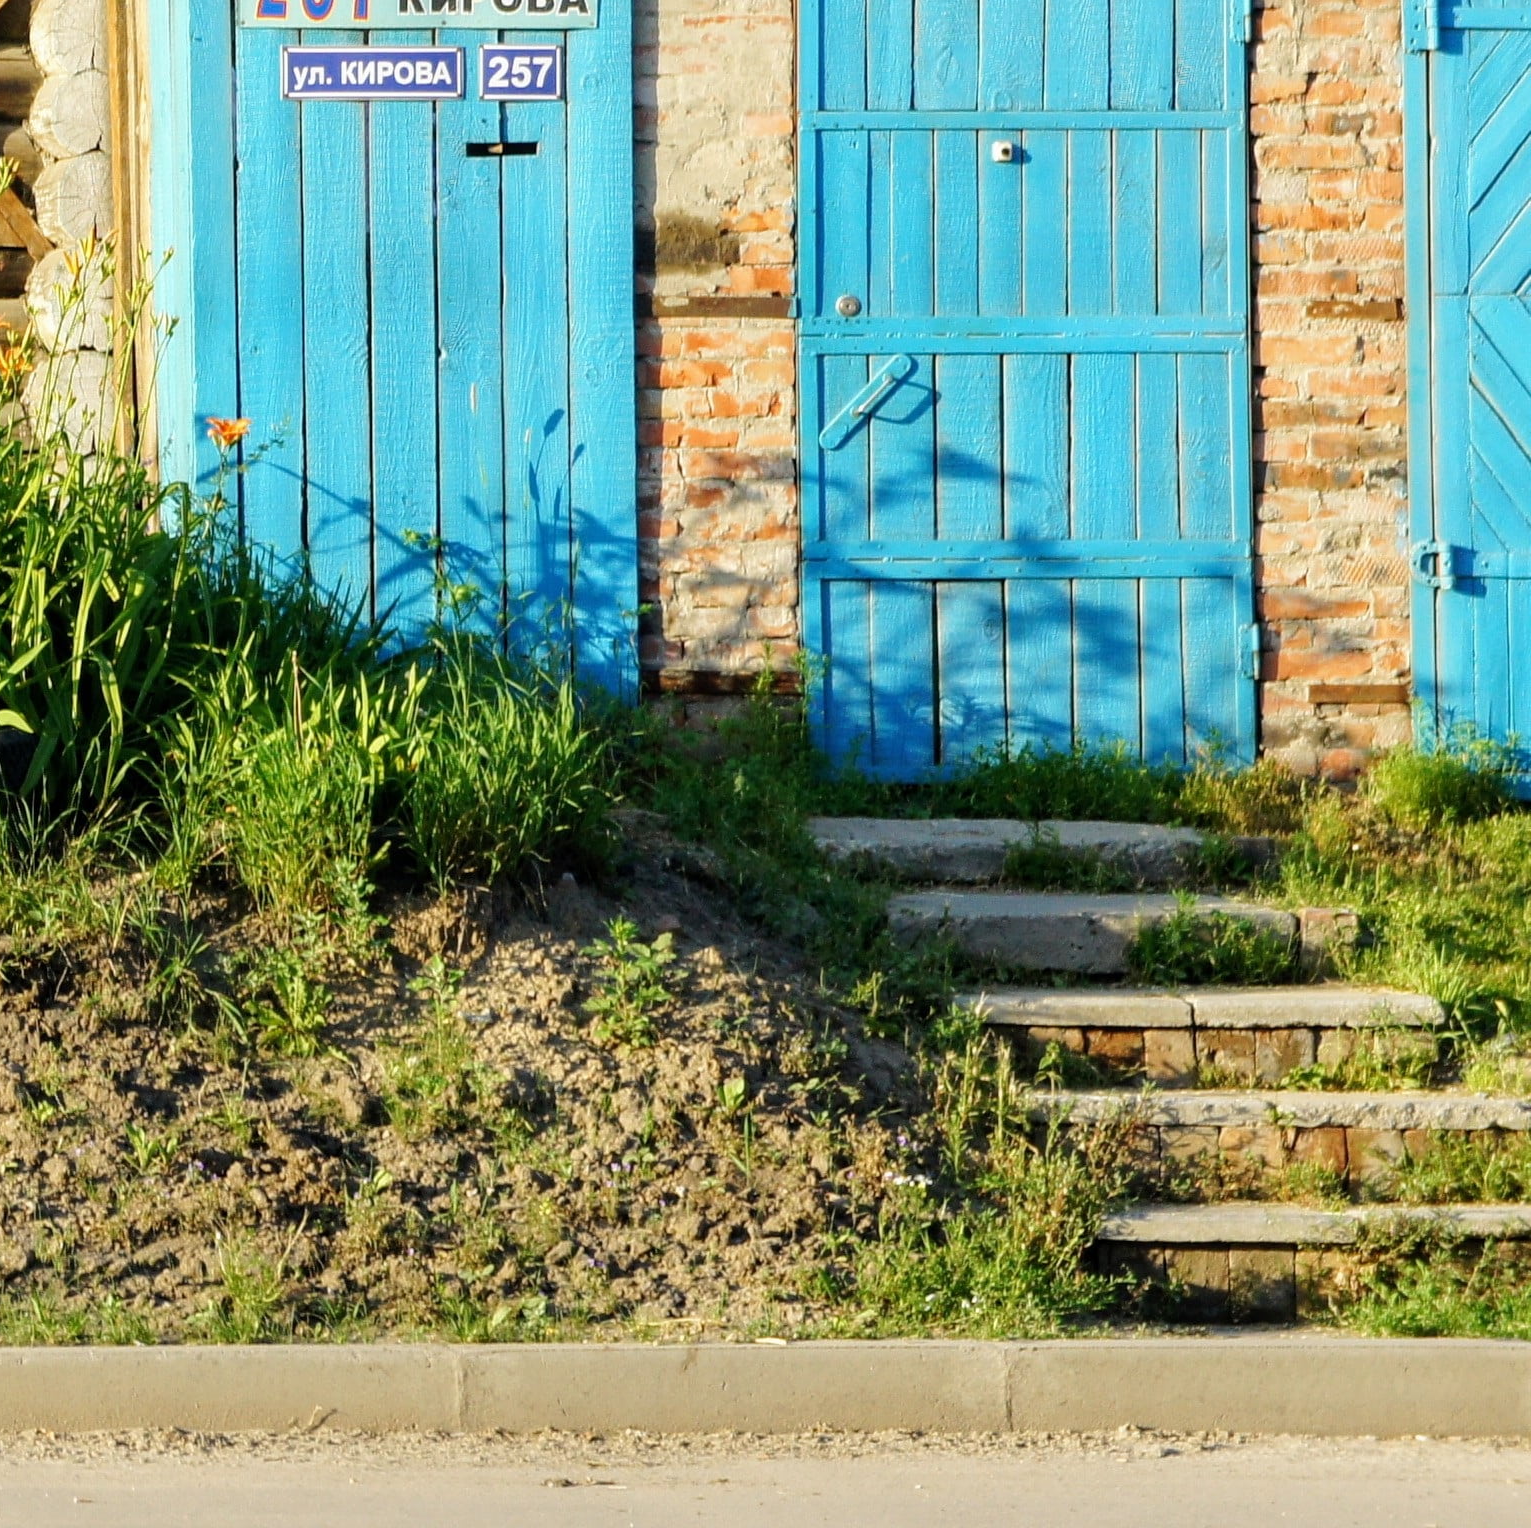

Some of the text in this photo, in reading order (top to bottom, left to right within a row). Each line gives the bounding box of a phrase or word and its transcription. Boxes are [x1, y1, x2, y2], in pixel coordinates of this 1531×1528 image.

[293, 61, 451, 90] ул. КИРОВА
[488, 57, 552, 88] 257
